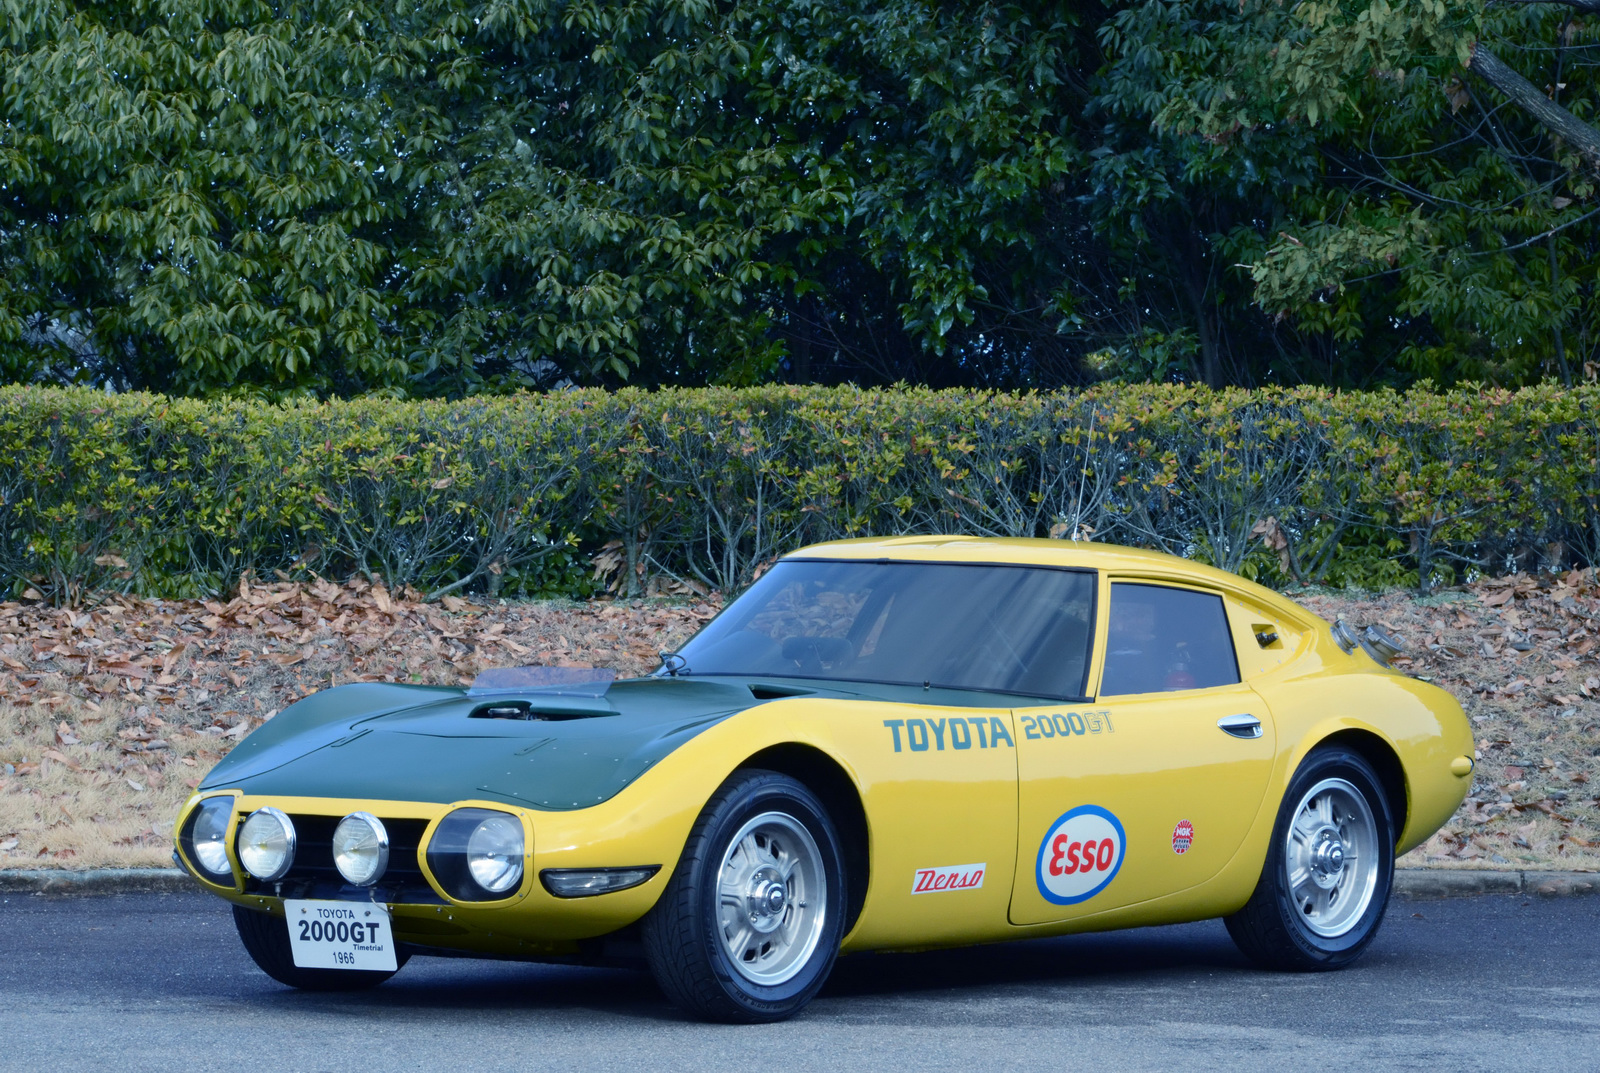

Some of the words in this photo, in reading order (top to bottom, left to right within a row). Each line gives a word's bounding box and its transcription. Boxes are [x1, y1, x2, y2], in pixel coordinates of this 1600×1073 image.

[883, 717, 1014, 752] TOYOTA
[1020, 709, 1114, 740] 2000GT
[1176, 827, 1192, 837] NGK
[914, 869, 983, 893] Denso
[317, 908, 355, 919] TOYOTA
[298, 919, 380, 944] 2000GT
[353, 944, 383, 952] Timetrial
[333, 952, 355, 964] 1966
